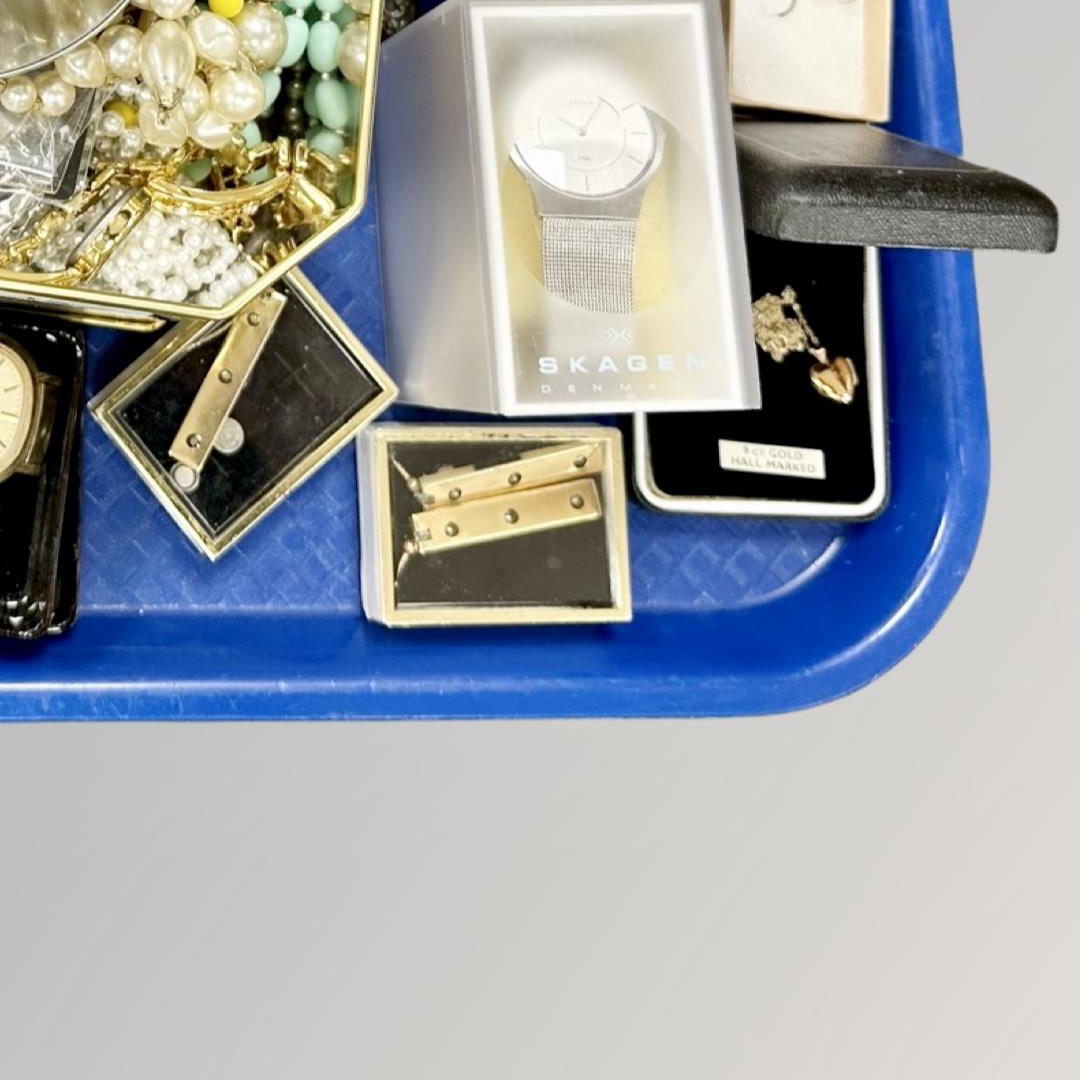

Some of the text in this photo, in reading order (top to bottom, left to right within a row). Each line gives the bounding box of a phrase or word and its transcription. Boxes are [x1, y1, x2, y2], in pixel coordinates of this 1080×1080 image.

[538, 352, 707, 375] SKAGEN
[768, 447, 803, 461] GOLD
[731, 455, 816, 473] HALL MARKED
